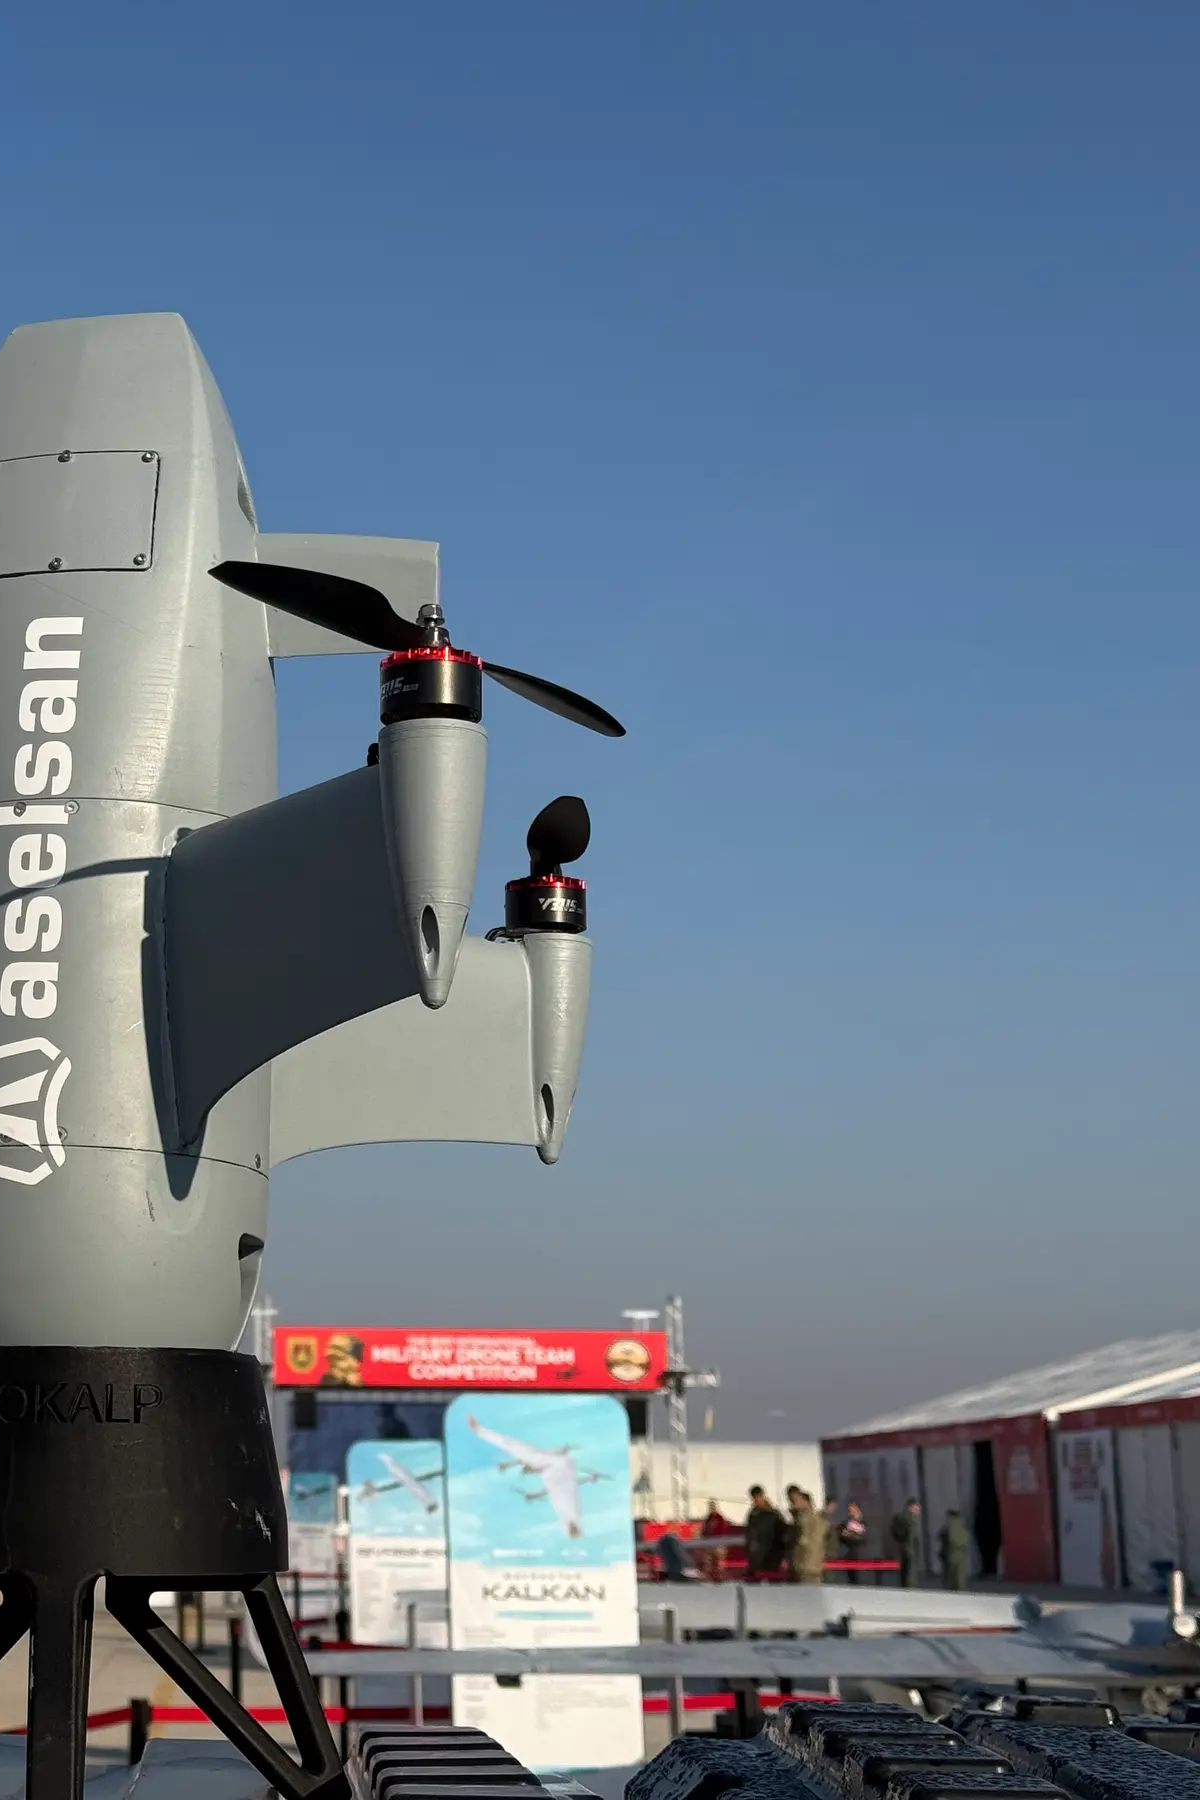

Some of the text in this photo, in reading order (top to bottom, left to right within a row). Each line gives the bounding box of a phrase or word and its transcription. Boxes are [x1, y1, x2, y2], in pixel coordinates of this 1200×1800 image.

[371, 1345, 575, 1365] MILITARY DRONE TEAM
[409, 1364, 538, 1381] COMPETITION
[481, 1584, 608, 1601] KALKAN
